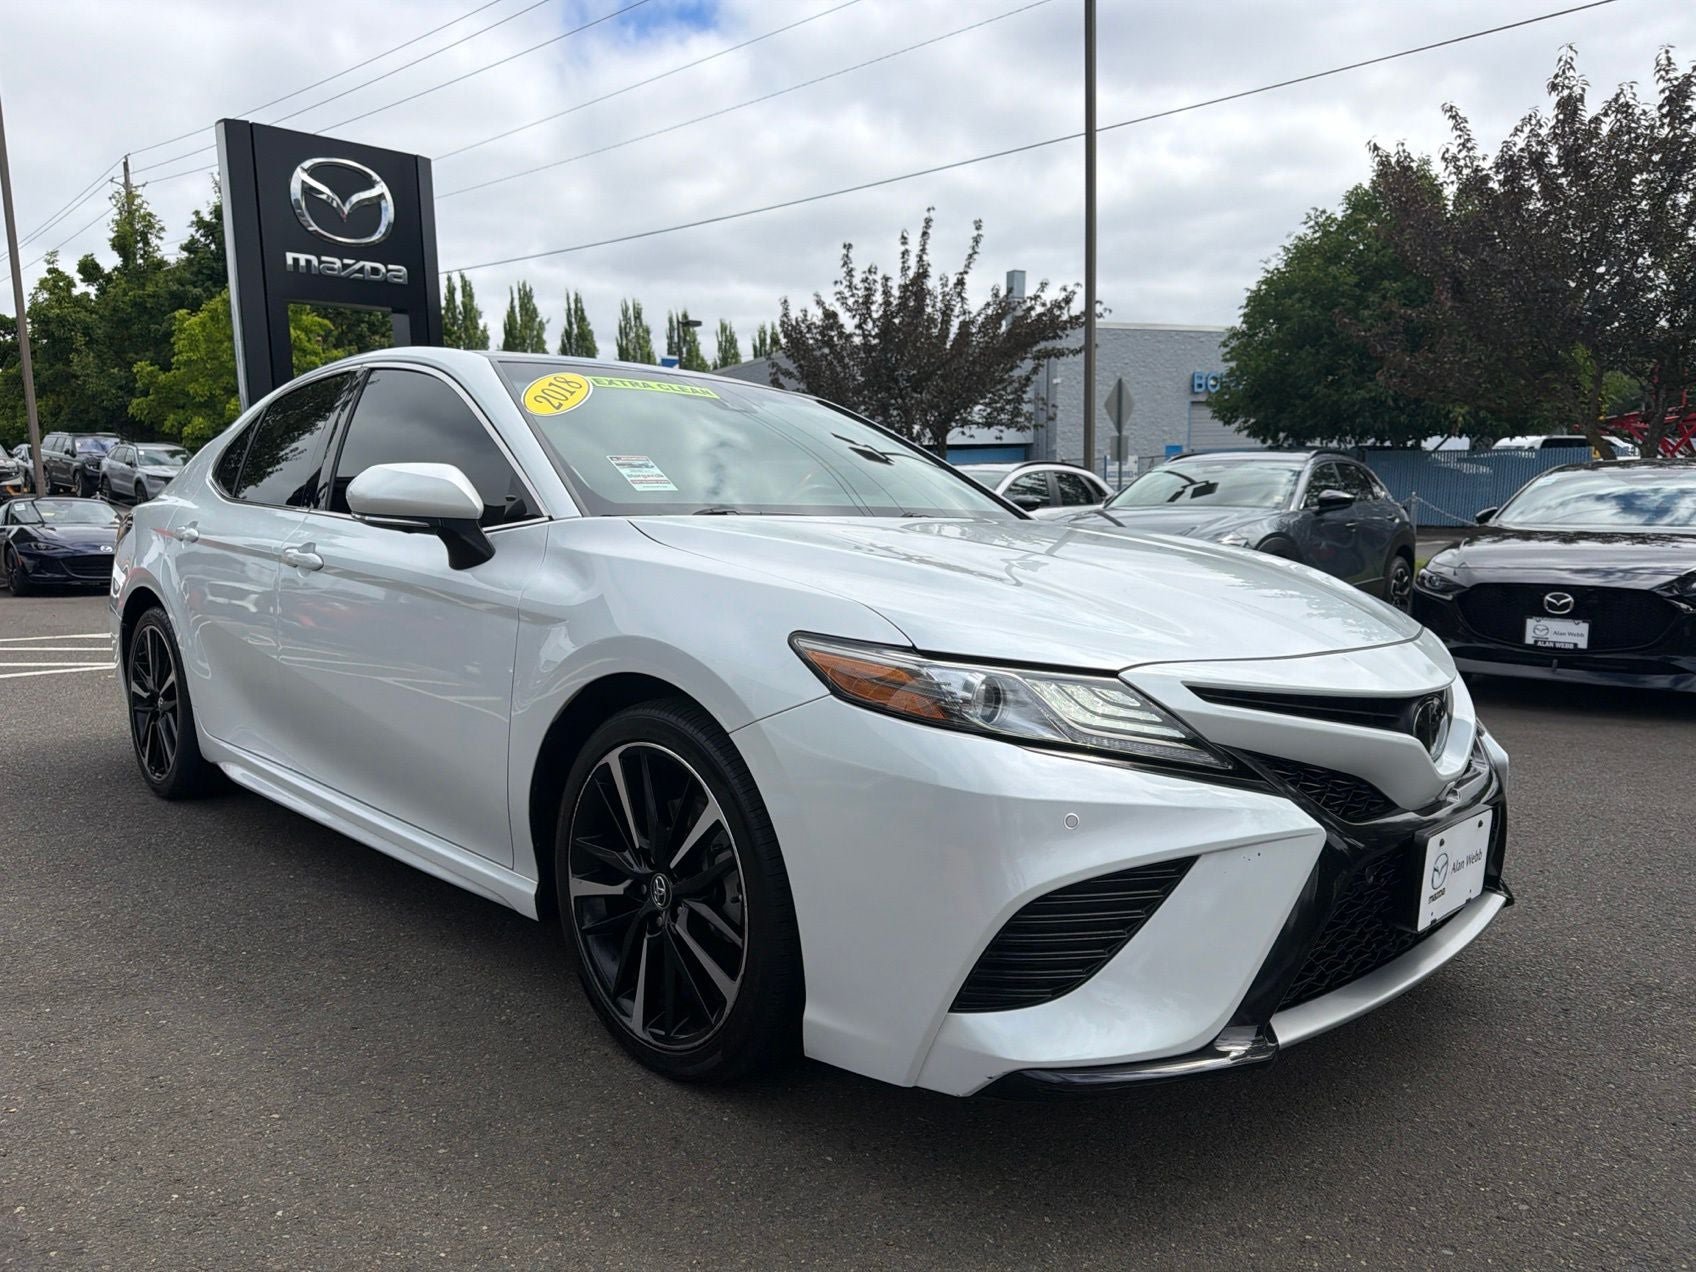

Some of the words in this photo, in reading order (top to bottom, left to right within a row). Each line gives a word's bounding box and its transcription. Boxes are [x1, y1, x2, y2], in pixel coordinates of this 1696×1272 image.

[534, 376, 583, 410] 2018
[592, 377, 654, 390] EXTRA
[656, 383, 712, 397] CLEAN
[1451, 860, 1465, 874] Alan
[1465, 848, 1483, 866] Webb
